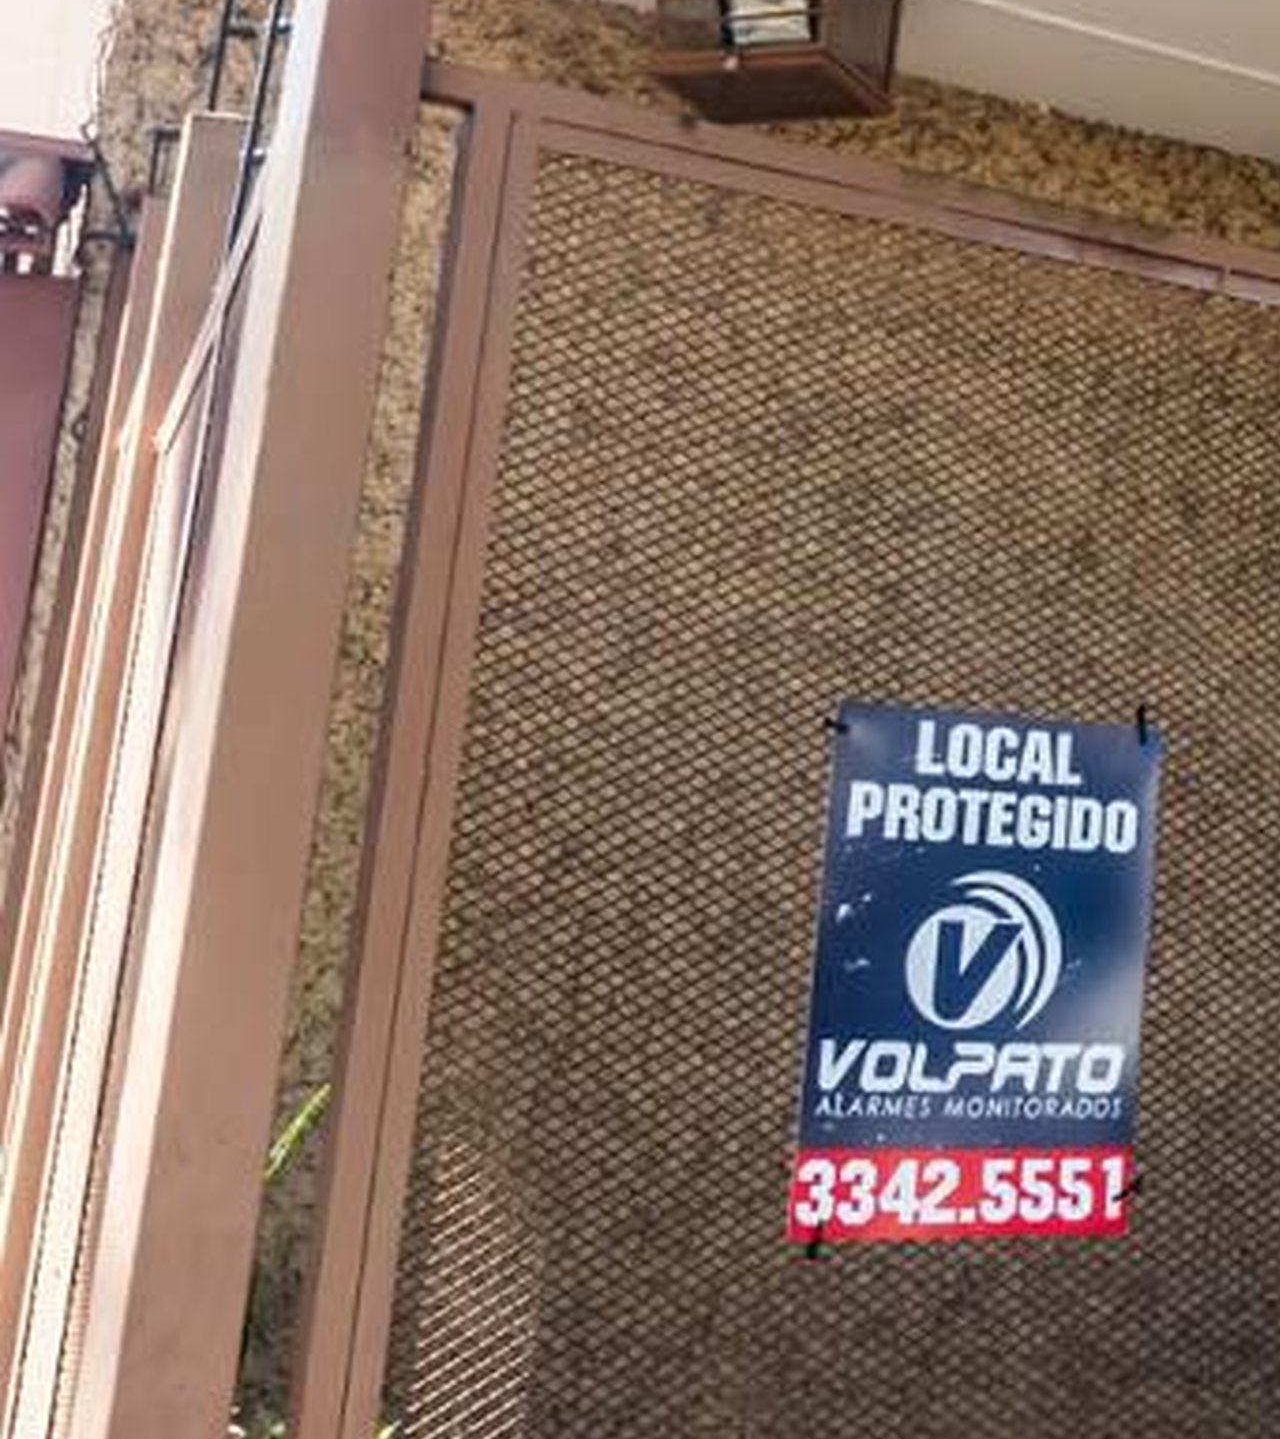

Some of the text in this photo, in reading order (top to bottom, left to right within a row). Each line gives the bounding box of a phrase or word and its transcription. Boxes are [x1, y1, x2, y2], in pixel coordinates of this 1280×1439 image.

[915, 720, 1082, 785] LOCAL
[845, 780, 1139, 854] PROTEGIDO
[817, 1039, 1127, 1093] VOLPATO
[814, 1091, 1124, 1121] ALARMES MONITORADOS
[794, 1155, 1126, 1228] 3342.5551
